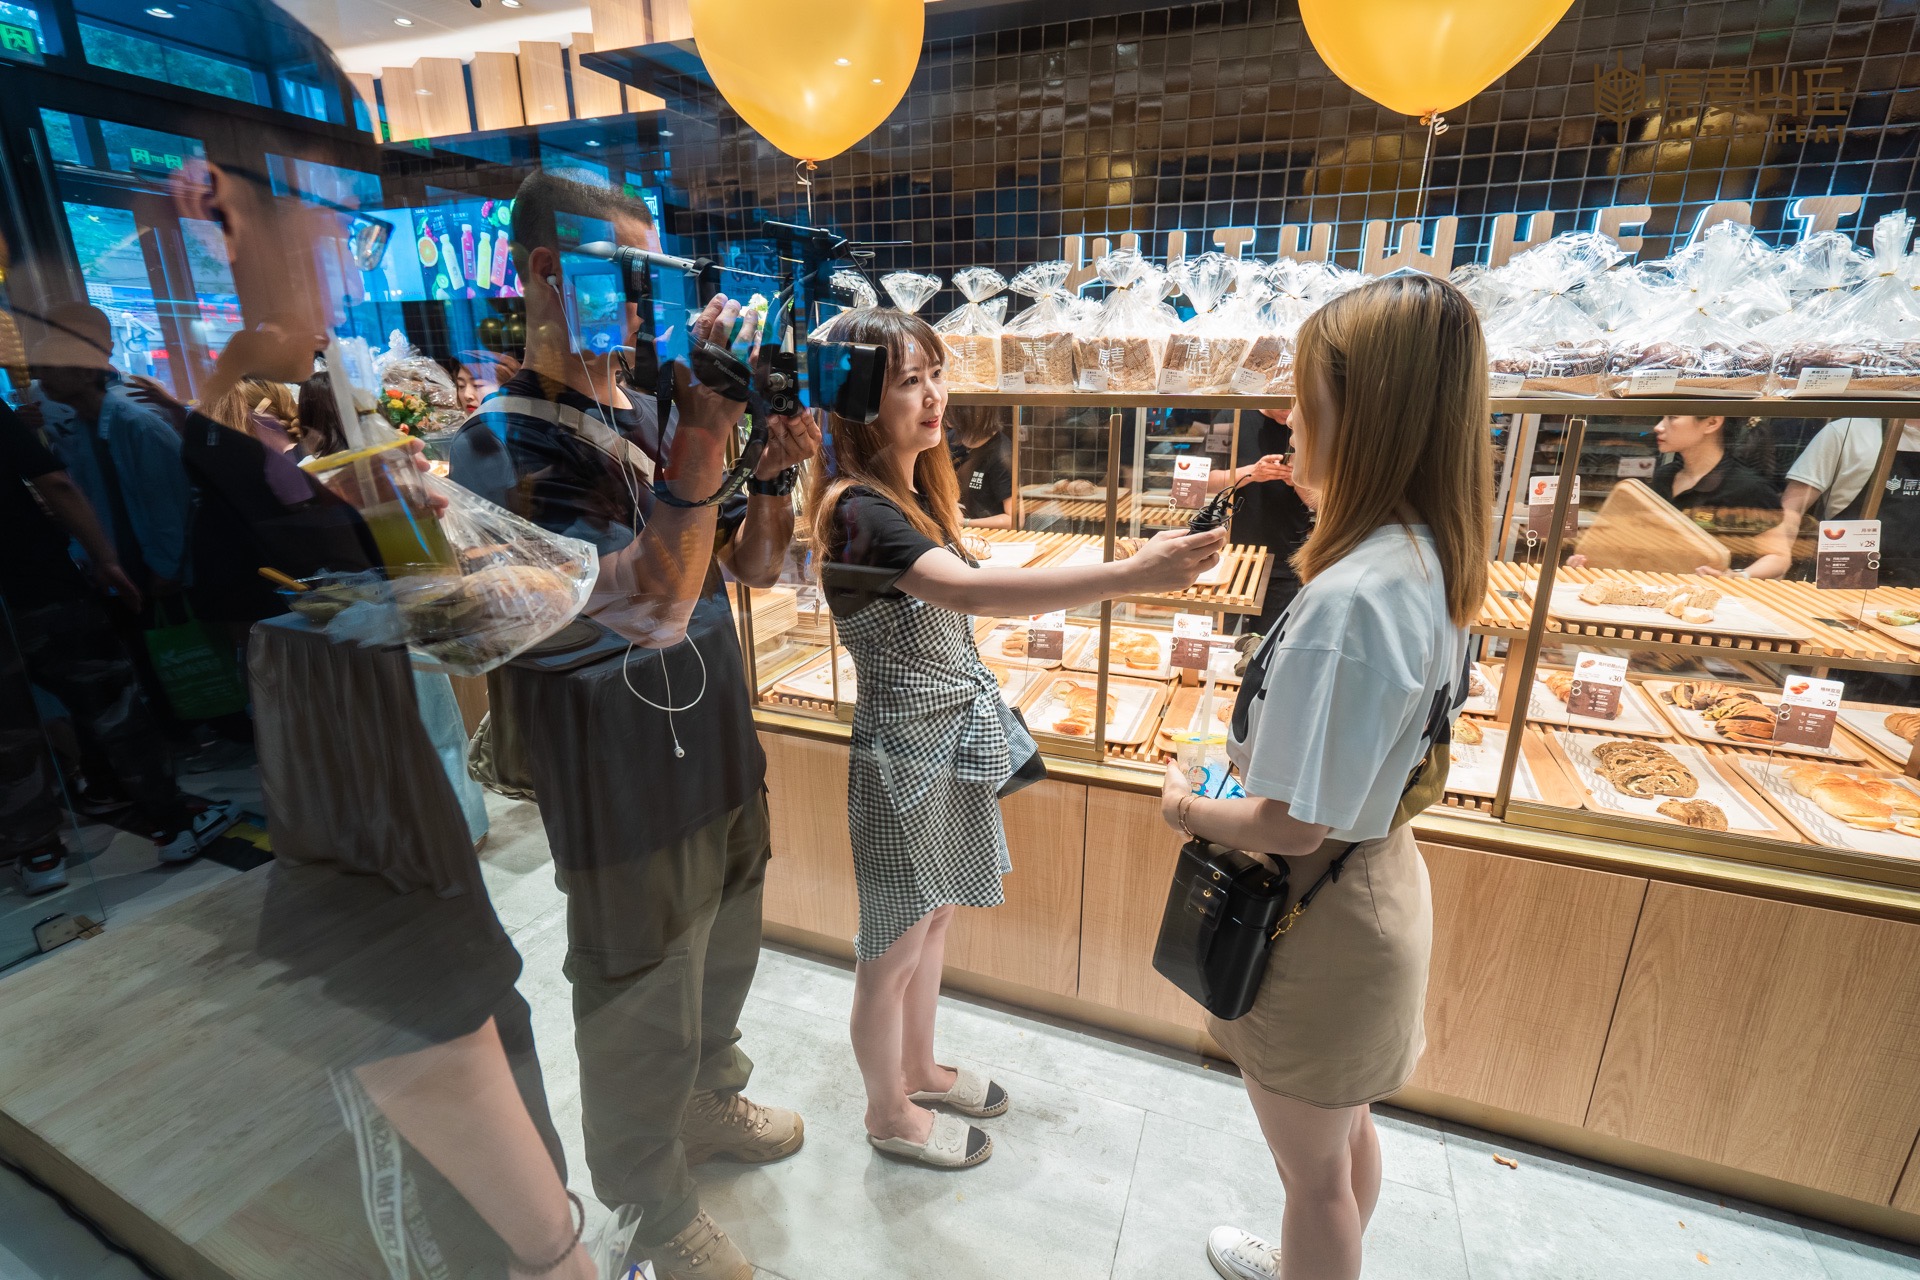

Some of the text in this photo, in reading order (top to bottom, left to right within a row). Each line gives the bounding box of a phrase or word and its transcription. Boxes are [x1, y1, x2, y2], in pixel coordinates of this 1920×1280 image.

[1655, 66, 1848, 117] 原麦山丘
[713, 359, 748, 386] Panasonic
